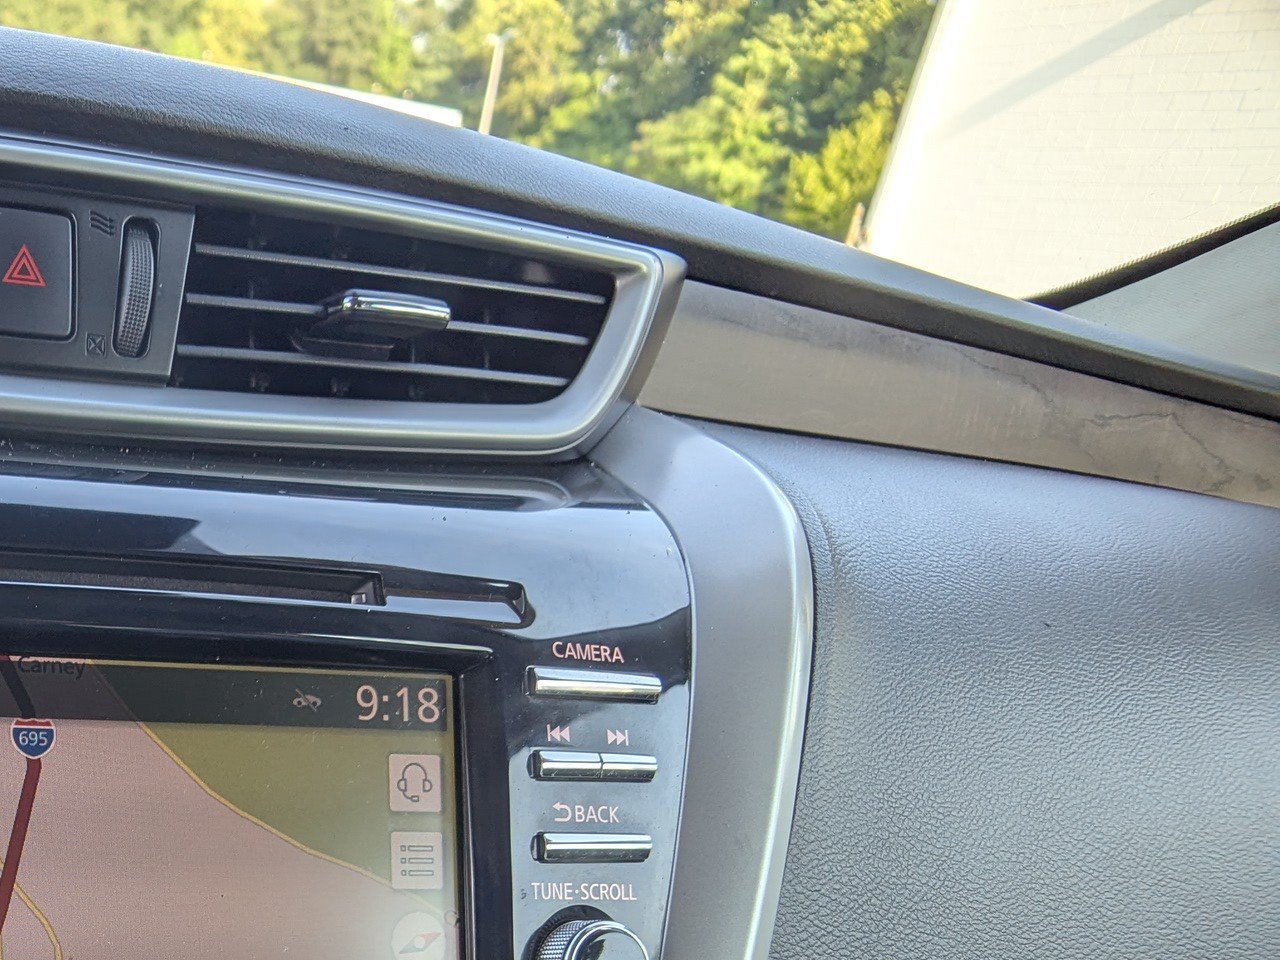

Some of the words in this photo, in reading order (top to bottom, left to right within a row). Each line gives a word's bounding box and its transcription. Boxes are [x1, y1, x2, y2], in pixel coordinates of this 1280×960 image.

[552, 641, 625, 663] CAMERA
[18, 656, 86, 681] Carney
[355, 683, 441, 724] 9:18
[18, 730, 48, 746] 695
[574, 804, 620, 824] BACK
